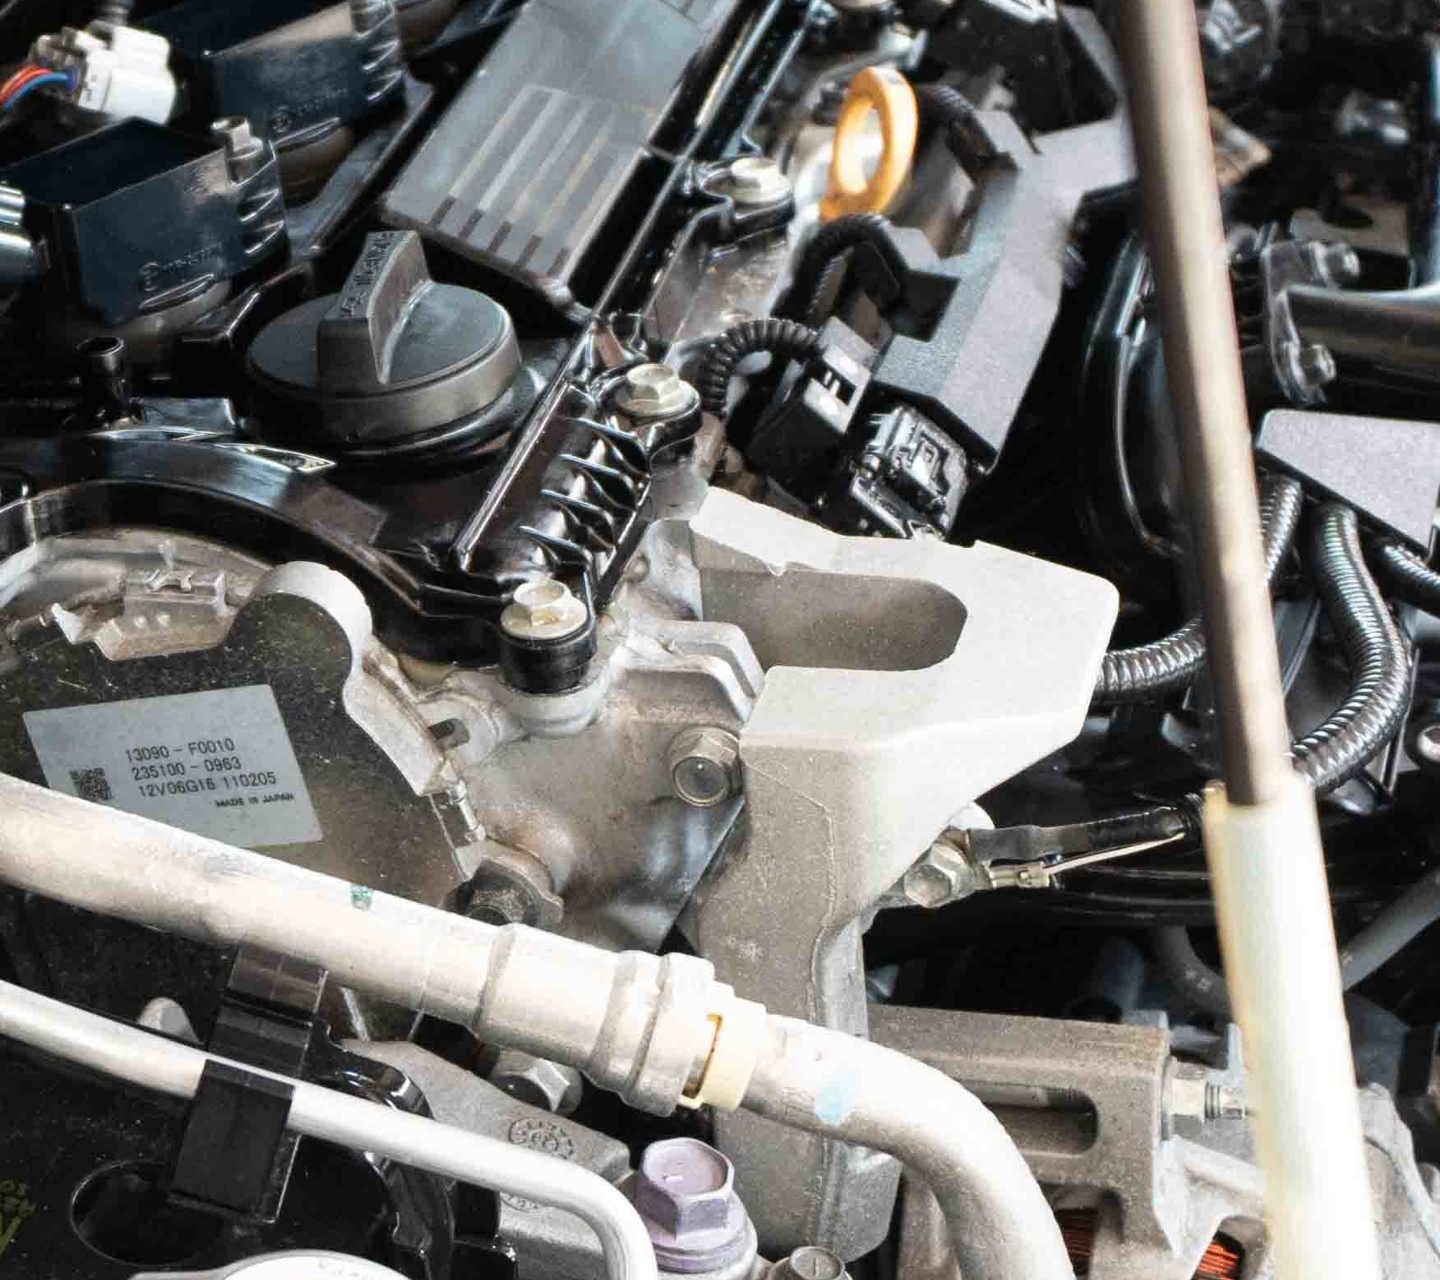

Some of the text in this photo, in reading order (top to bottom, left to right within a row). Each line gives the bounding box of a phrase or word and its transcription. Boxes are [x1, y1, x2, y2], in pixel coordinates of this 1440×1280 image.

[125, 745, 170, 763] 13090
[188, 738, 236, 756] F0010
[131, 761, 185, 781] 235100
[204, 756, 242, 773] 0963
[223, 771, 278, 789] 110205
[215, 792, 295, 807] MADE IN JAPAN
